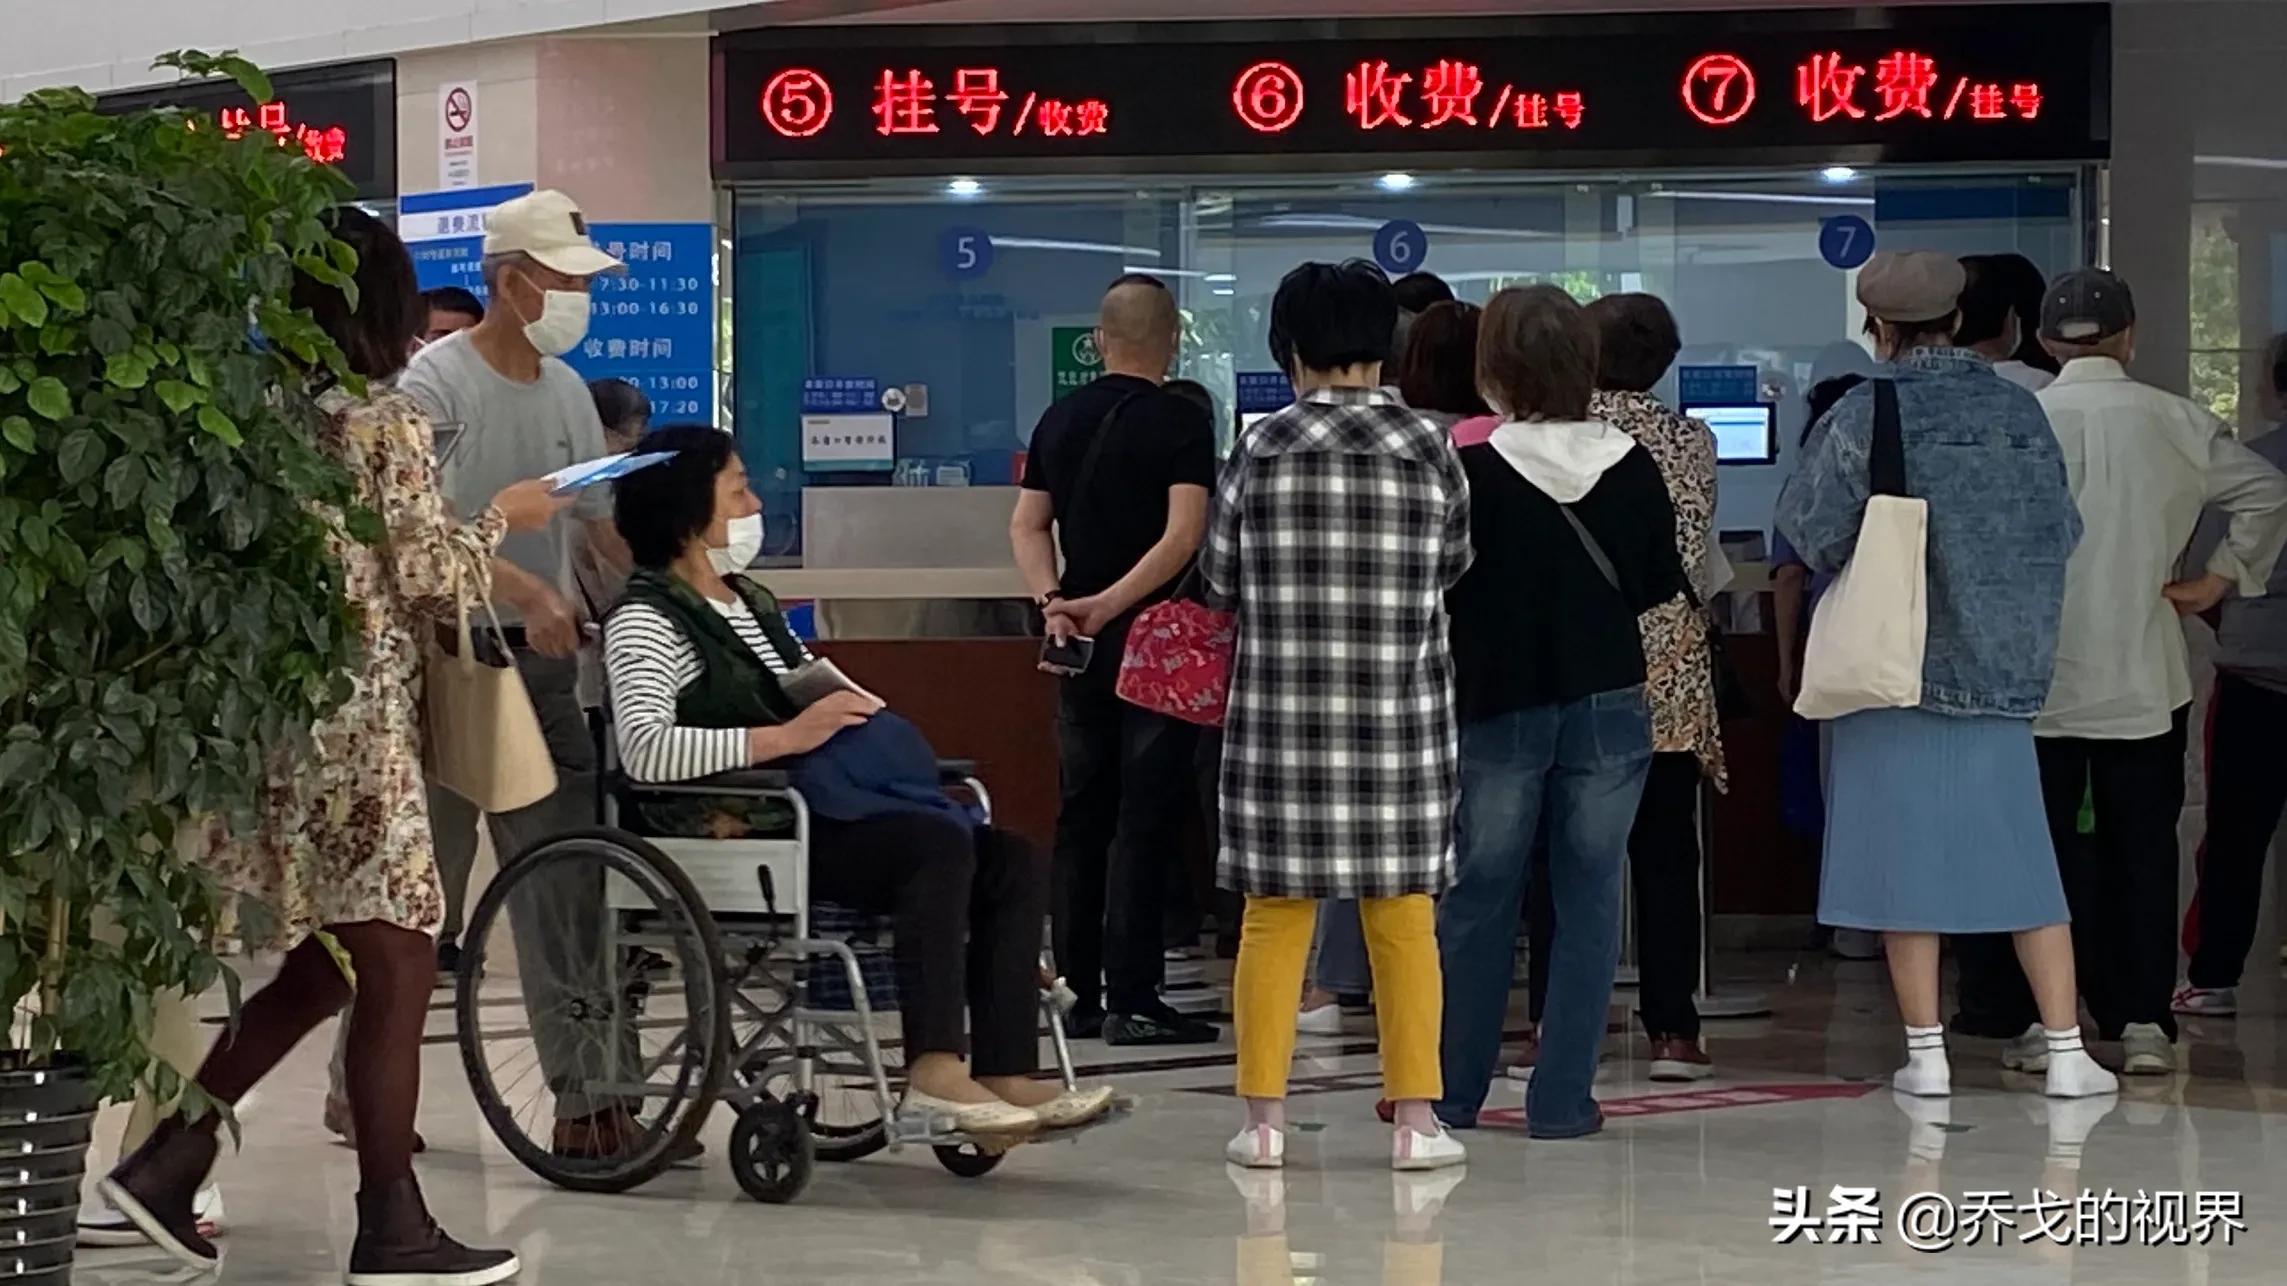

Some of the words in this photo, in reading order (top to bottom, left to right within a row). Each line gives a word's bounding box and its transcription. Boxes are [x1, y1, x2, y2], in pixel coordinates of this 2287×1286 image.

[871, 68, 1109, 137] 挂号/收费
[1346, 59, 1585, 130] 收费/挂号
[1797, 51, 2043, 122] 收费/挂号
[958, 237, 976, 269] 5
[1389, 231, 1411, 263] 6
[1836, 230, 1857, 259] 7
[583, 337, 672, 359] 收费时间
